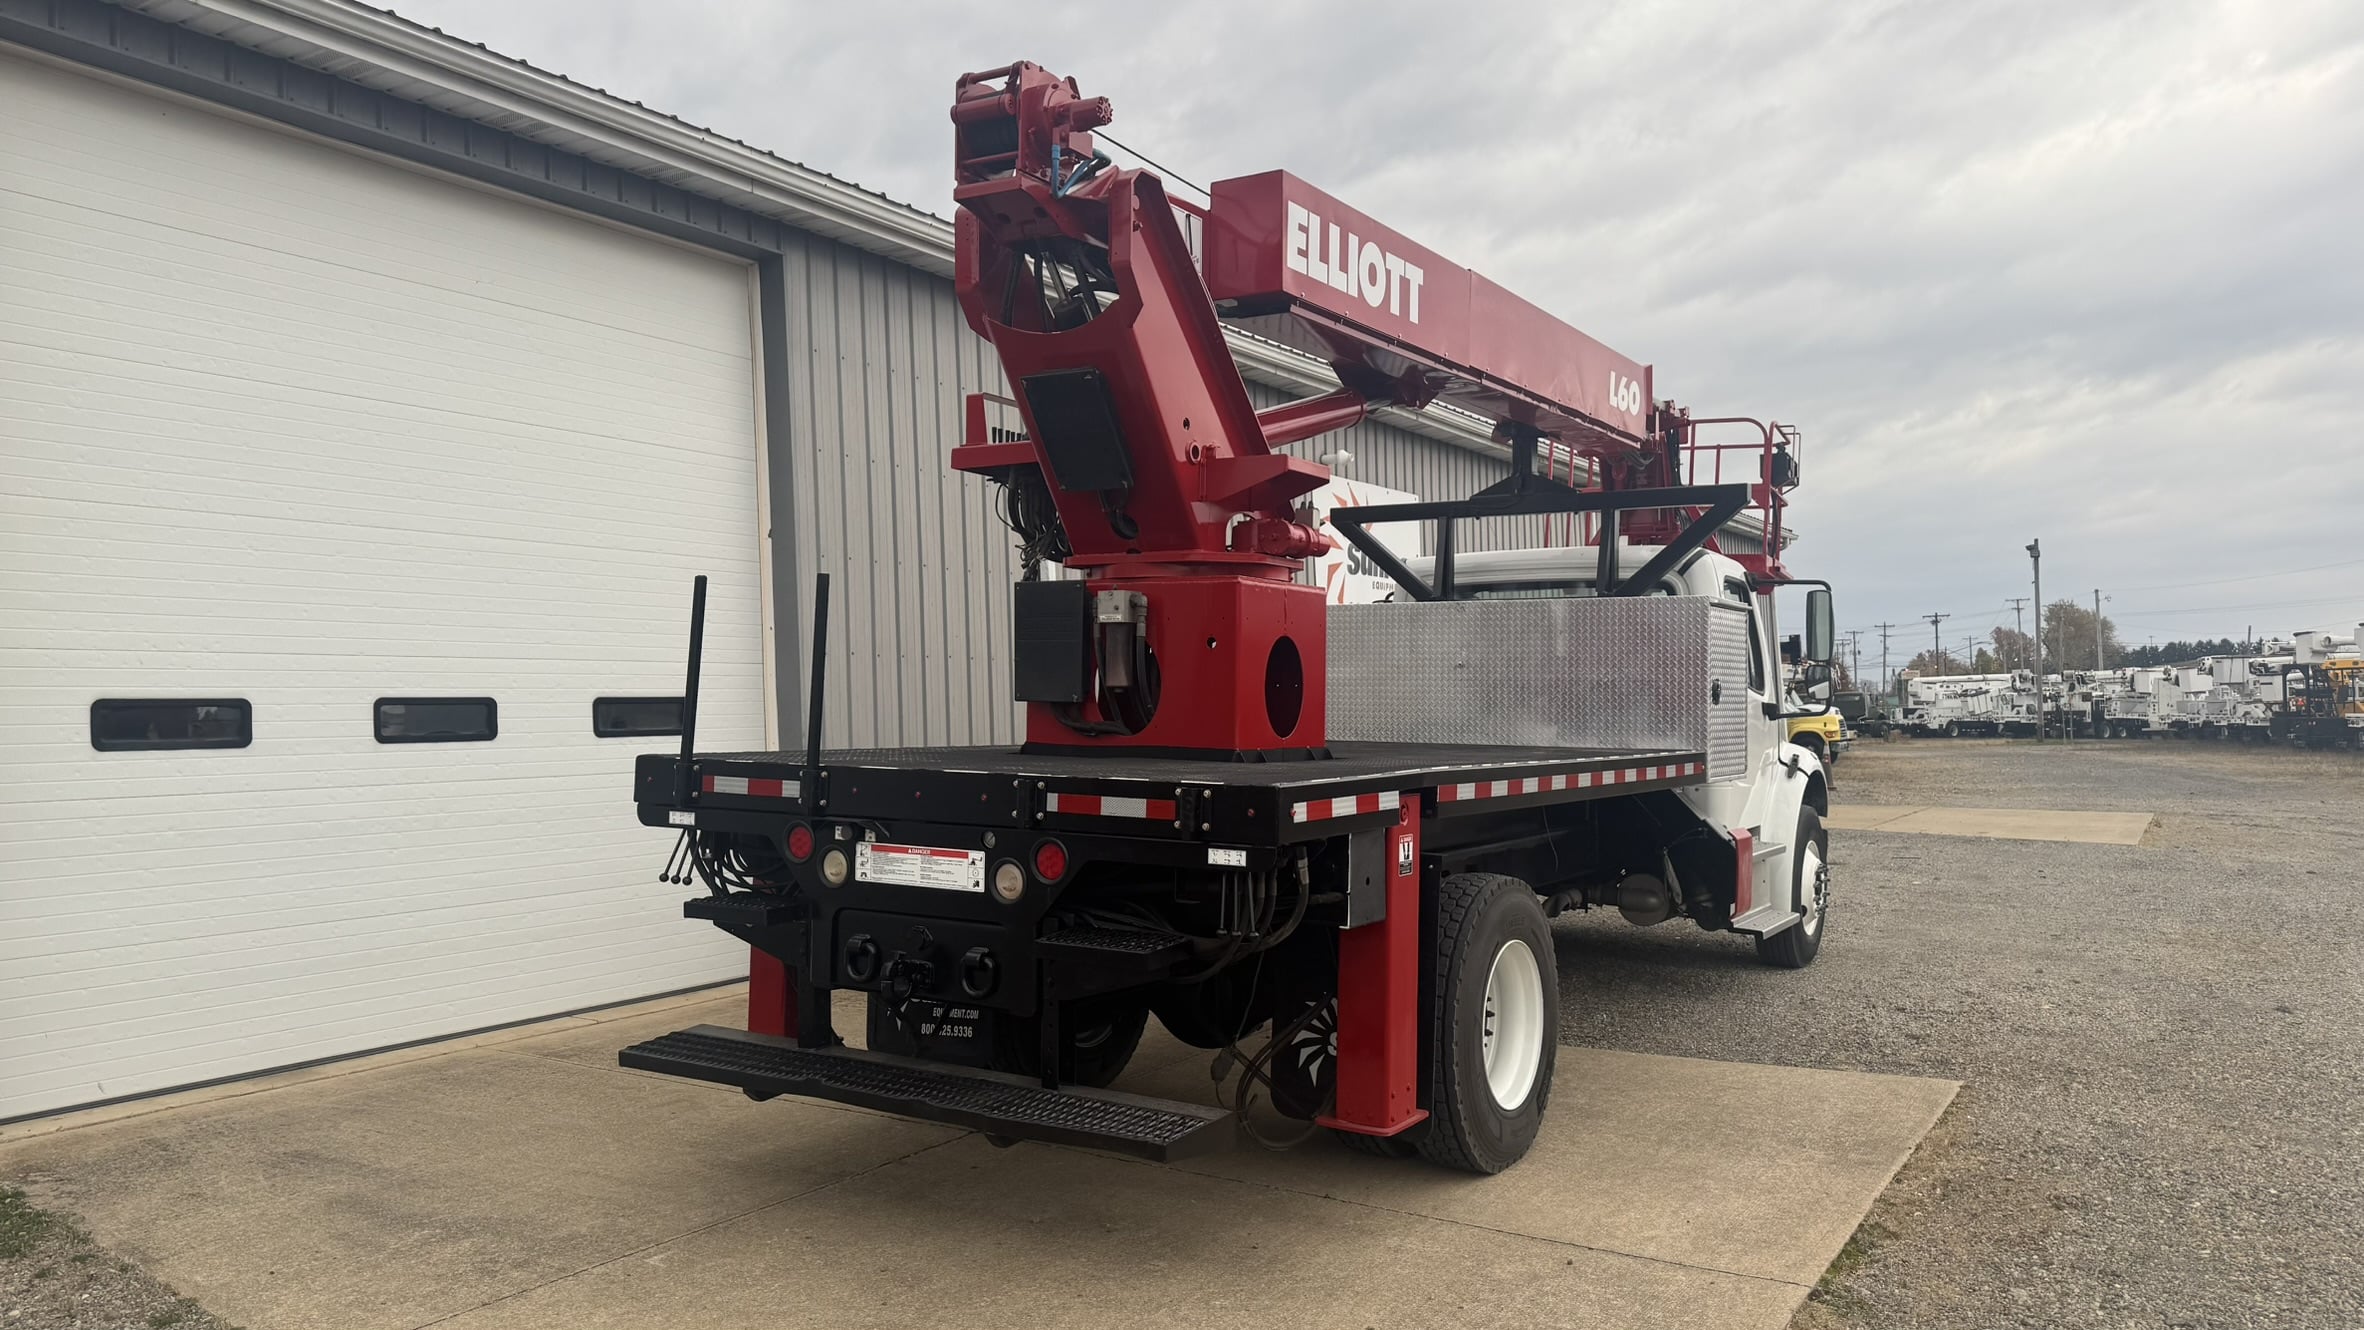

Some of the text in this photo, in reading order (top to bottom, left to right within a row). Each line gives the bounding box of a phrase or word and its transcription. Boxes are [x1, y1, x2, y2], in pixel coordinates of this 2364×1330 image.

[1286, 199, 1424, 325] ELLIOTT
[1609, 370, 1641, 417] L60
[932, 1007, 980, 1020] EQMENT.COM
[920, 1023, 974, 1038] 80025.9336
